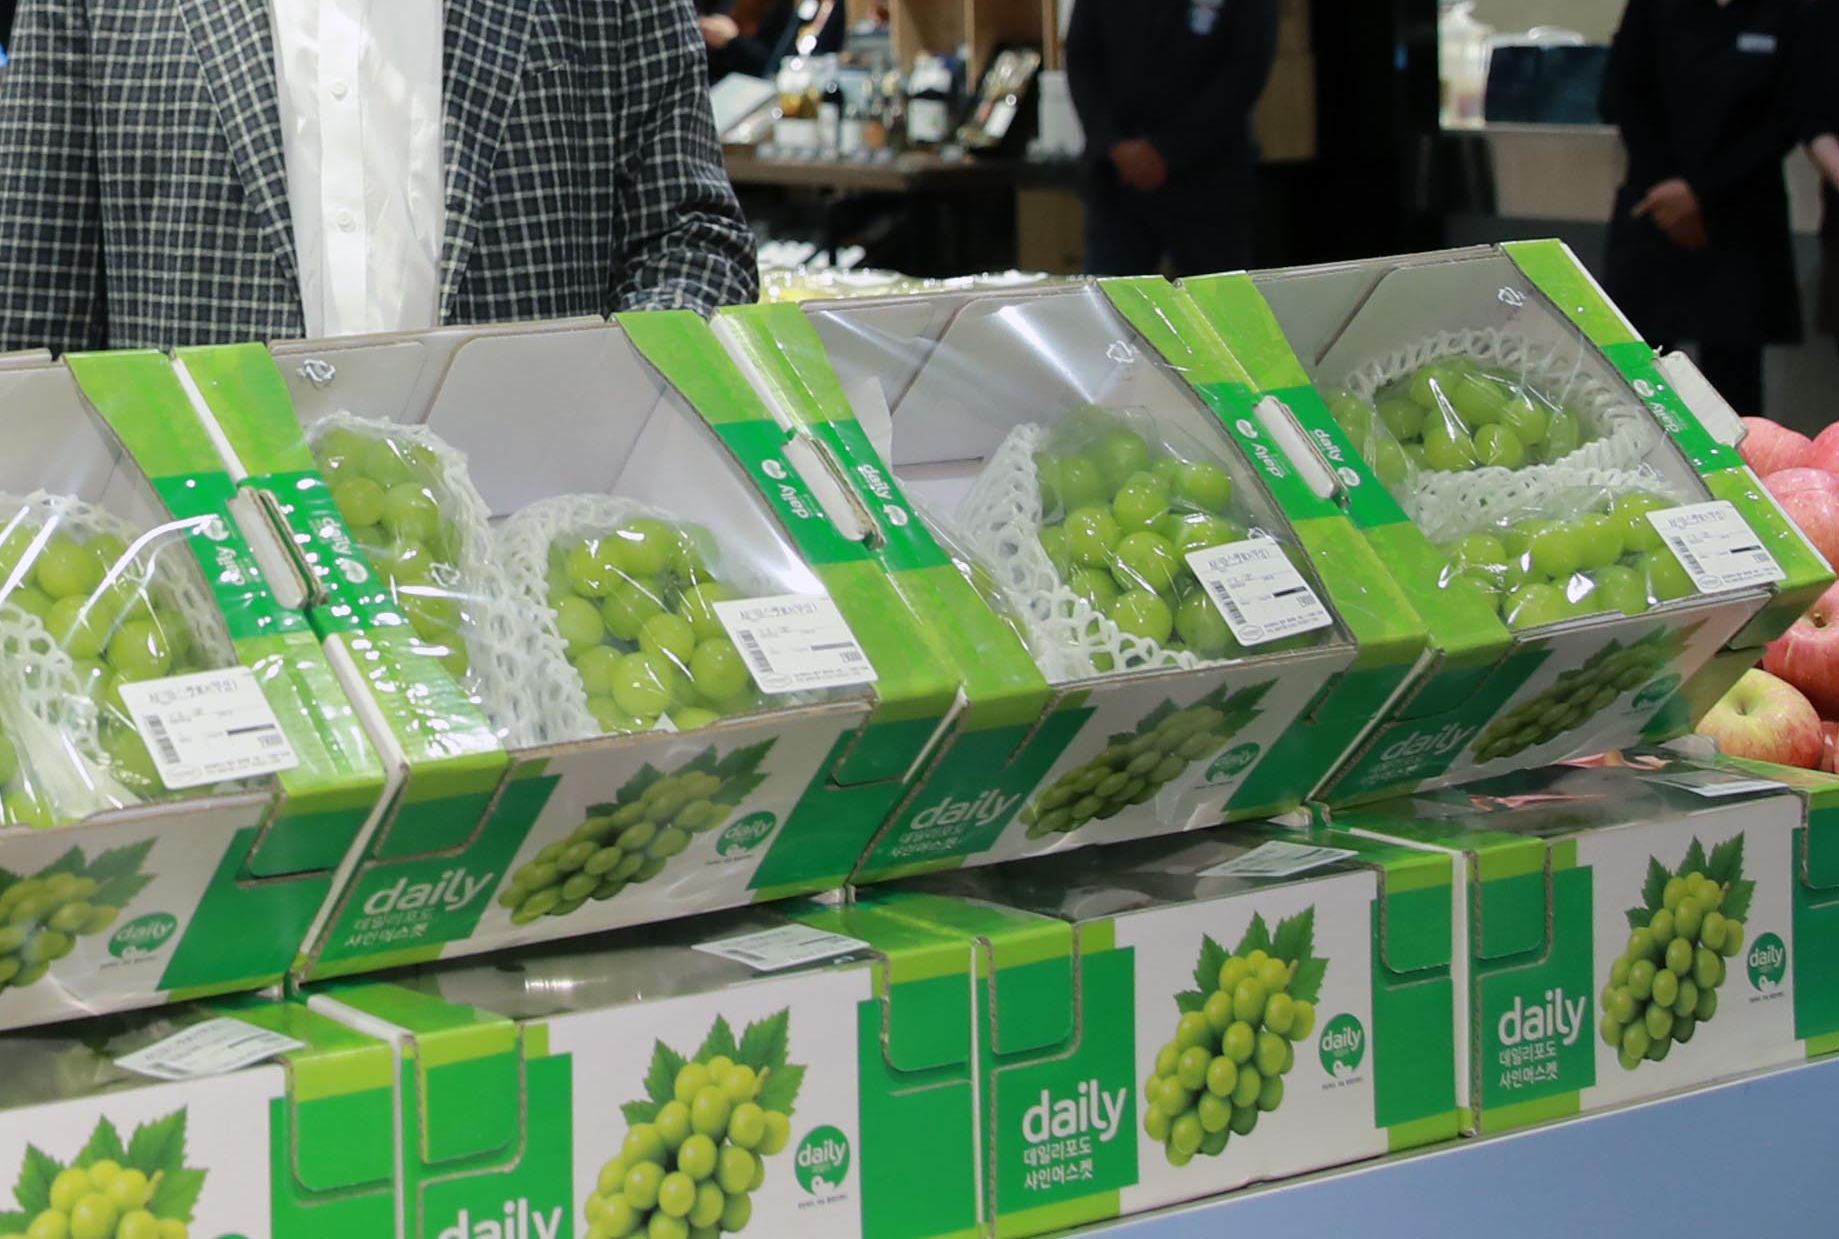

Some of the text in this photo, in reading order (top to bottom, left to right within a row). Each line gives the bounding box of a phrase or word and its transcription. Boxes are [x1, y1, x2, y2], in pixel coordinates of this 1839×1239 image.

[1314, 428, 1345, 462] daily
[860, 464, 894, 501] daily
[1380, 722, 1478, 761] daily
[909, 788, 1022, 831] daily
[363, 867, 496, 916] daily
[1749, 944, 1784, 968] daily
[1498, 987, 1587, 1046] daily
[1321, 1026, 1362, 1051] daily
[1499, 1040, 1557, 1067] 데일리포도
[1022, 1078, 1128, 1144] daily
[798, 1138, 847, 1168] daily
[1023, 1136, 1092, 1166] 데일리포도
